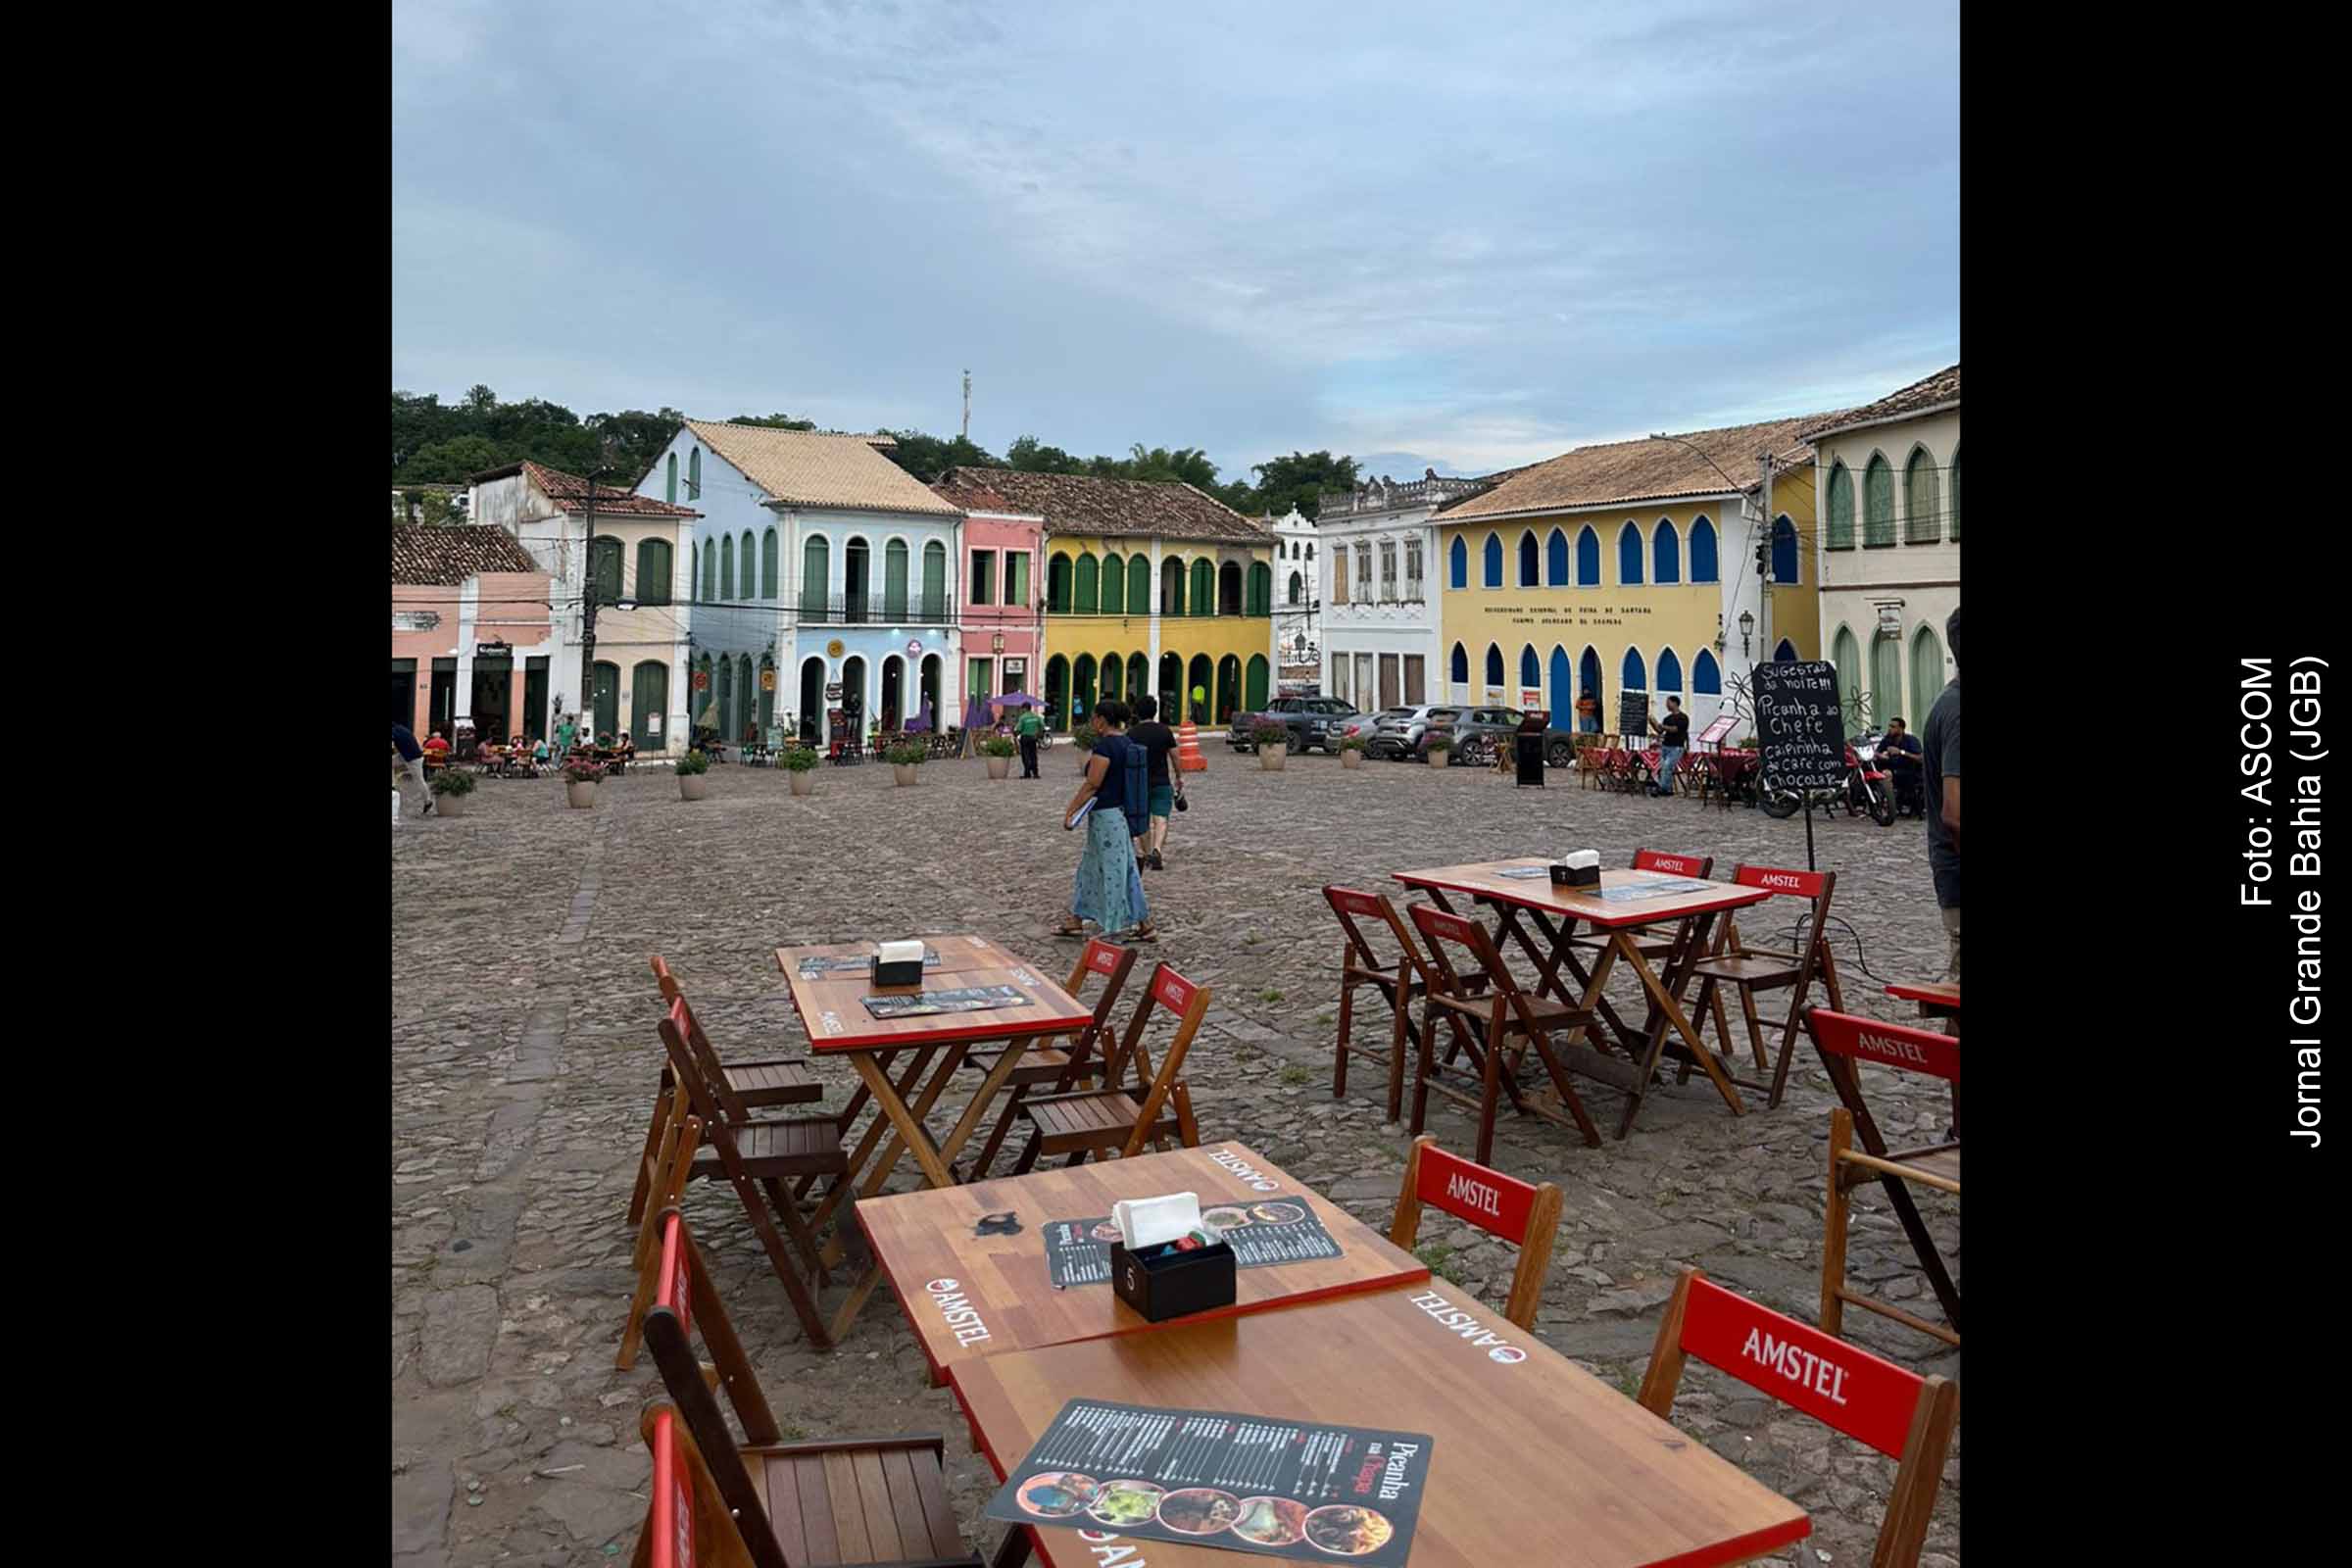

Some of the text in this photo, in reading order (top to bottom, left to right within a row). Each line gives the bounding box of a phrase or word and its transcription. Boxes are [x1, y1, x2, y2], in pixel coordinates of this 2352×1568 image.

[1757, 694, 1820, 716] Picanha
[1769, 716, 1823, 734] Chefe
[1654, 858, 1685, 872] AMSTEL
[1761, 873, 1800, 889] AMSTEL
[1858, 1032, 1929, 1064] AMSTEL
[1206, 1148, 1264, 1182] AMSTEL
[1446, 1171, 1501, 1216] AMSTEL
[1126, 1266, 1136, 1291] 5
[932, 1291, 993, 1348] AMSTEL
[1409, 1290, 1508, 1346] AMSTEL
[1741, 1326, 1850, 1405] AMSTEL
[1378, 1442, 1419, 1499] Picanha
